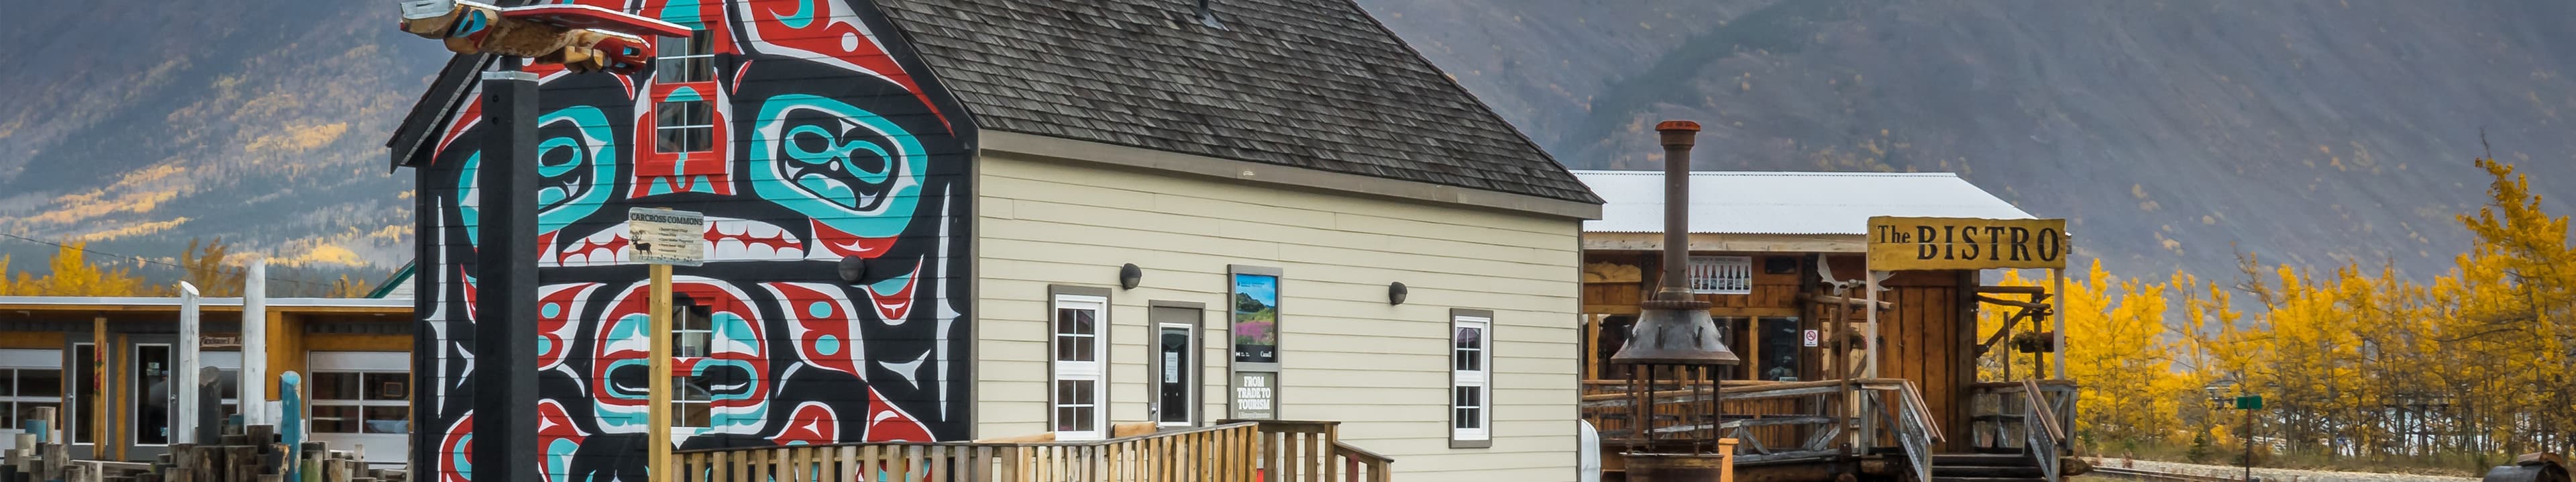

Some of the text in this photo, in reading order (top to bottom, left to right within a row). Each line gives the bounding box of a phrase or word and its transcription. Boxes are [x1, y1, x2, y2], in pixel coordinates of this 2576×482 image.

[631, 213, 703, 226] CARCROSS COMMONS
[1878, 225, 2059, 262] The BISTRO
[1244, 376, 1265, 387] FROM
[1236, 387, 1271, 399] TRADE TO
[1237, 399, 1270, 409] TOURISM
